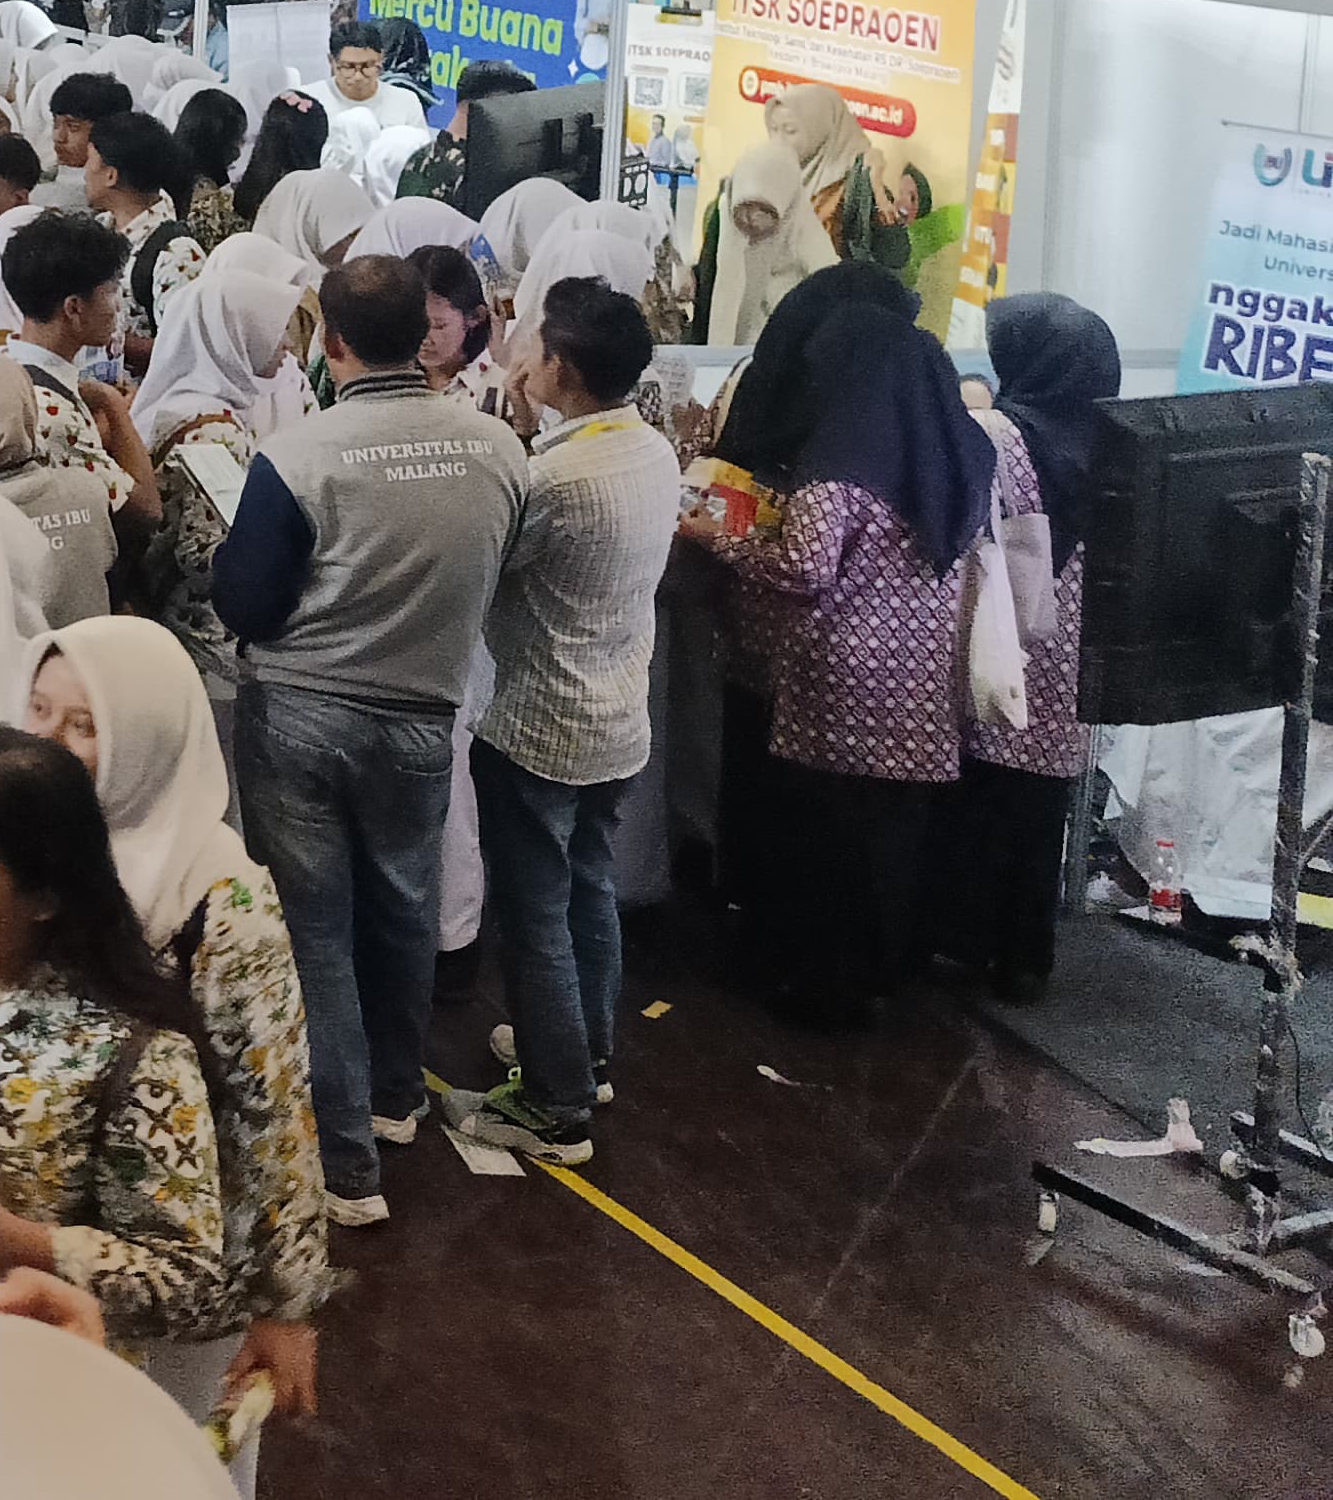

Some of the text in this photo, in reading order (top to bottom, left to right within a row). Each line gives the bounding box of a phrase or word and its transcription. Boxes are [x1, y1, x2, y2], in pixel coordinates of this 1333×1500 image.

[1219, 219, 1261, 243] Jadi
[1208, 281, 1333, 327] nggak
[340, 438, 494, 465] UNIVERSITAS IBU
[385, 461, 468, 483] MALANG
[64, 508, 91, 526] IBU
